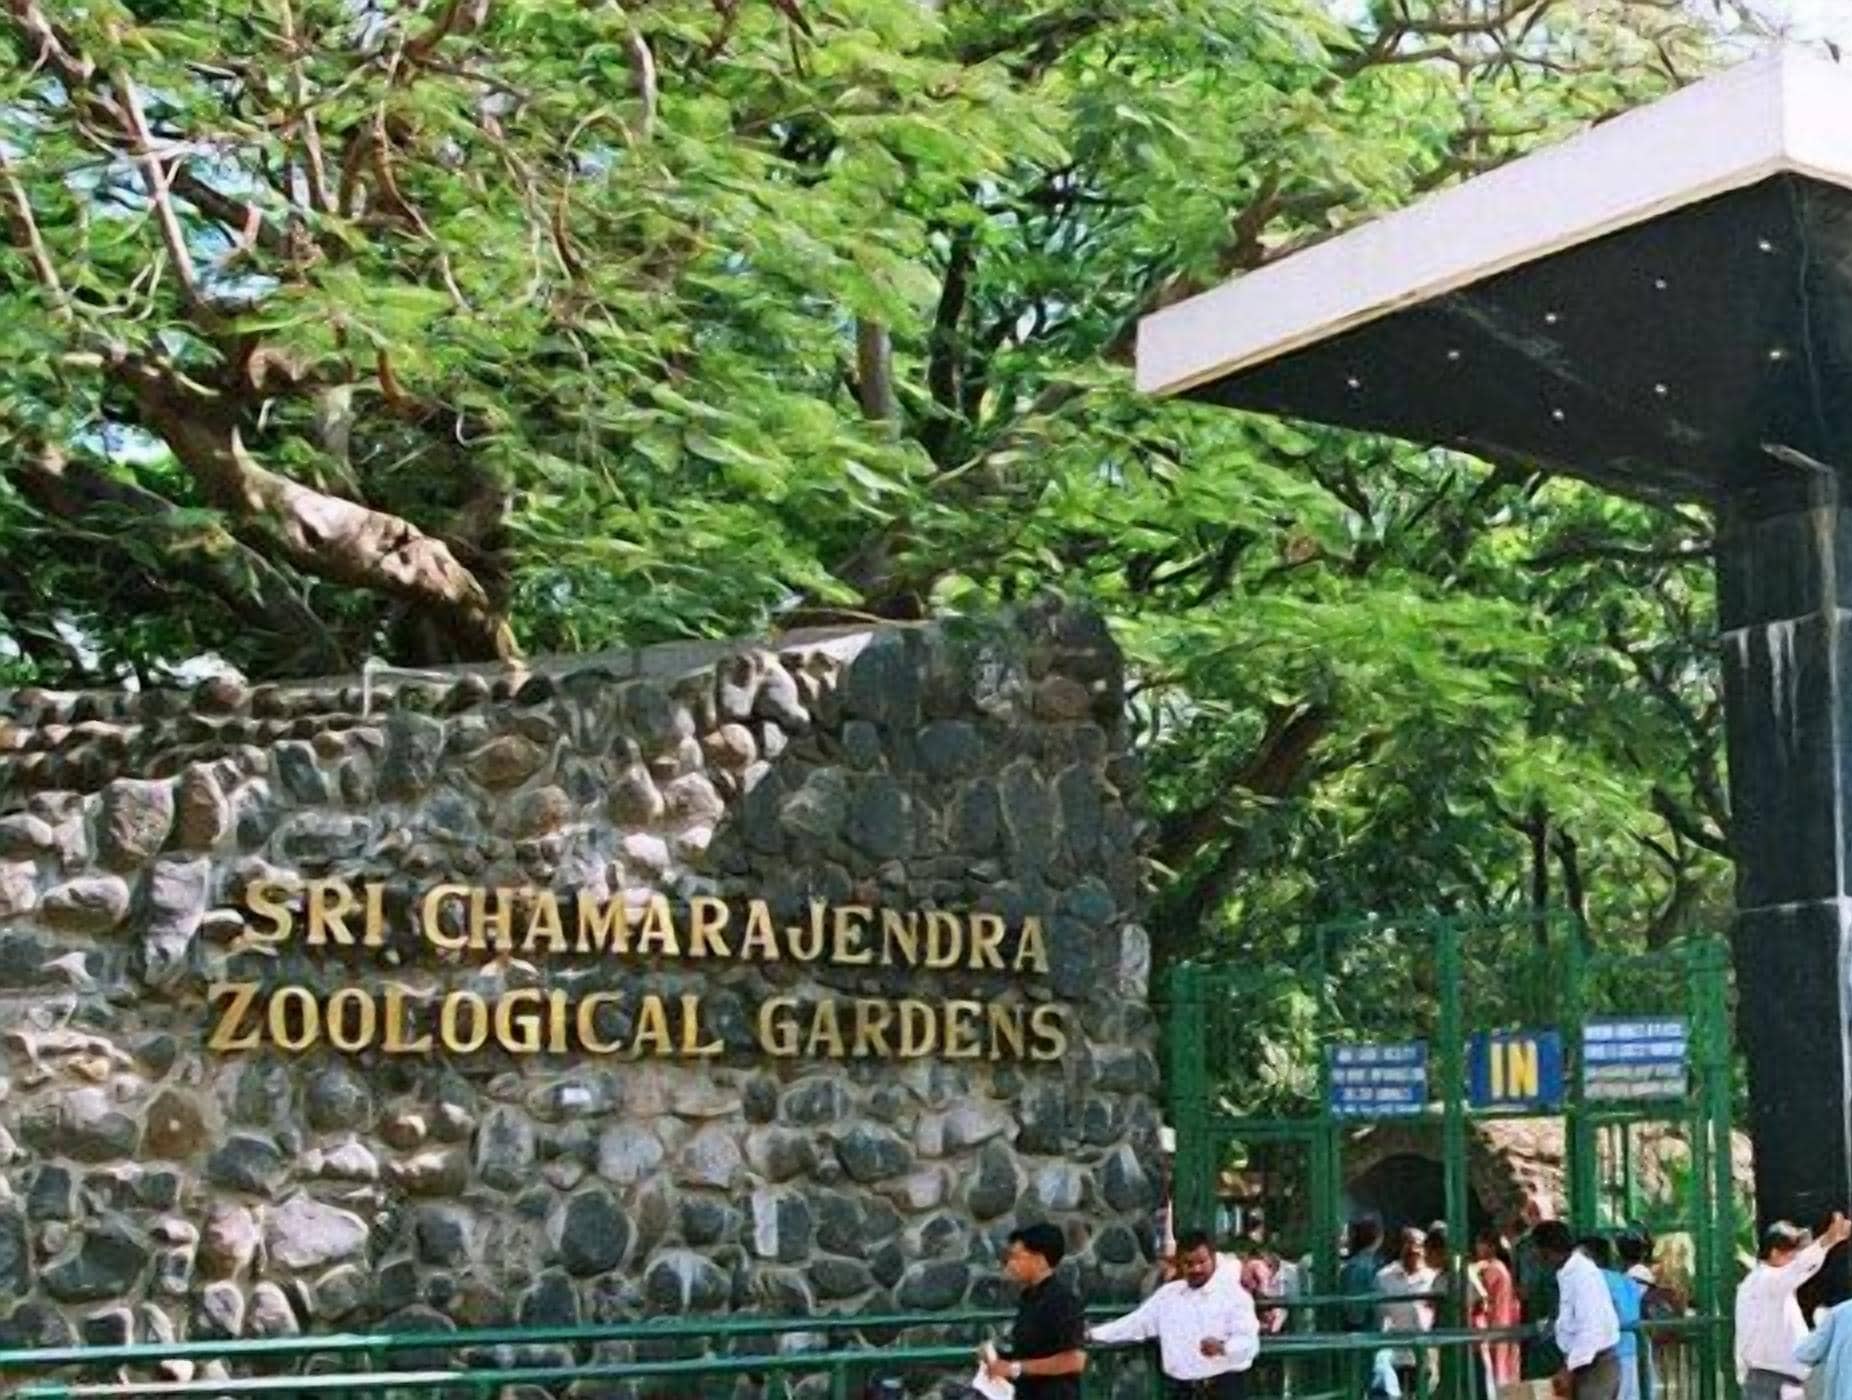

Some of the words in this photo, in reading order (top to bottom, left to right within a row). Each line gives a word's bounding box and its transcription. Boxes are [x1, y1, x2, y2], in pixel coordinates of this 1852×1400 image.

[244, 879, 385, 949] SRI
[422, 882, 1050, 974] CHAMARAJENDRA
[206, 981, 725, 1058] ZOOLOGICAL
[758, 998, 1068, 1063] GARDENS
[1490, 1039, 1539, 1099] IN
